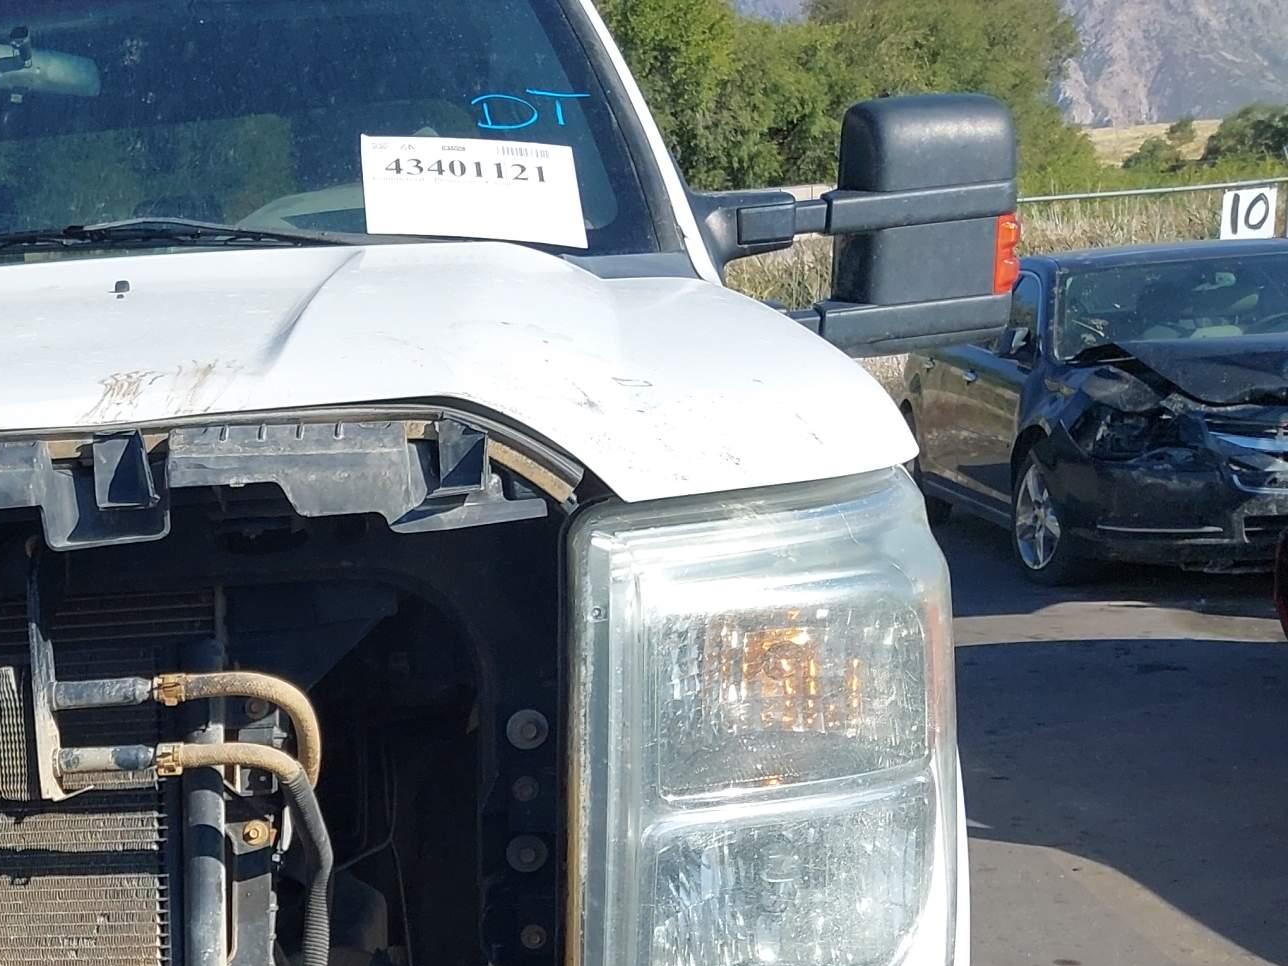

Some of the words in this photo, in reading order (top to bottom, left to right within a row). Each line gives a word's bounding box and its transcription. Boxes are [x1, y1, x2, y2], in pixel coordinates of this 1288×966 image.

[471, 88, 591, 130] DT
[384, 157, 547, 183] 43401121
[1230, 192, 1270, 235] 10
